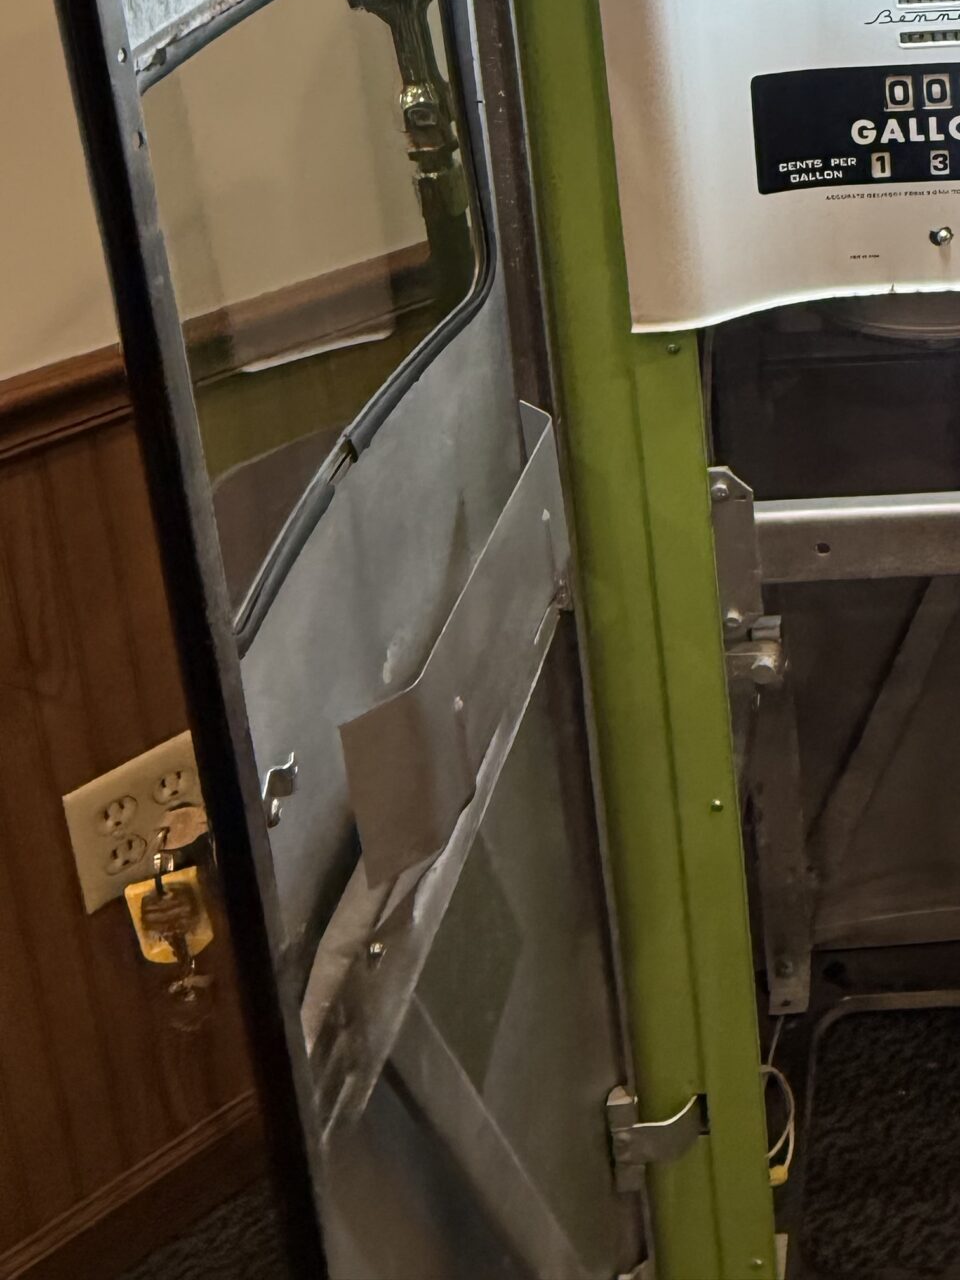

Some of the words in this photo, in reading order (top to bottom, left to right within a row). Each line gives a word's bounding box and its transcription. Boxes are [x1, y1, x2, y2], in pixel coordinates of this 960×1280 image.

[778, 159, 823, 173] CENTS
[830, 157, 857, 167] PER
[931, 153, 949, 172] 3
[790, 170, 843, 183] GALLON
